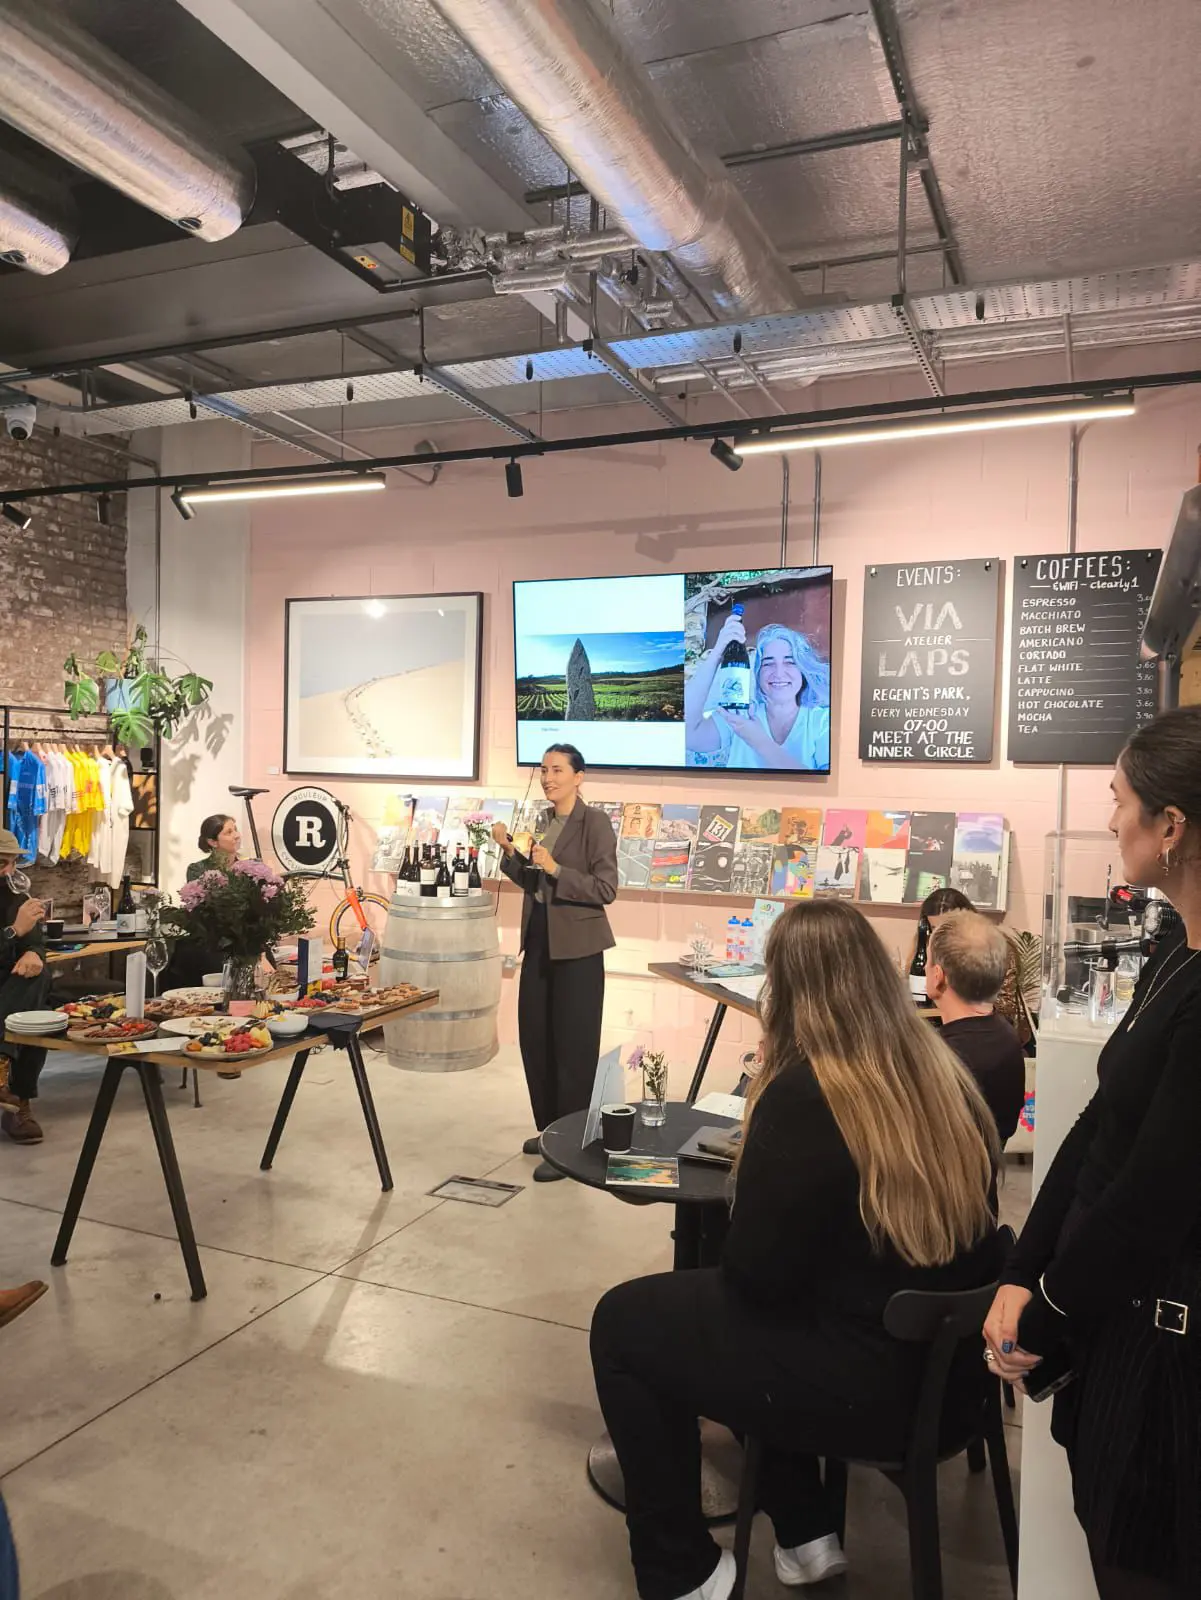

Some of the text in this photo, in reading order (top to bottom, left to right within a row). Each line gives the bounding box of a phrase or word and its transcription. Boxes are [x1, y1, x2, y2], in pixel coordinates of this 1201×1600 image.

[1036, 555, 1131, 580] COFFEES:
[896, 565, 961, 587] EVENTS:
[1022, 598, 1076, 608] ESPRESSO
[895, 601, 962, 632] VIA
[1021, 610, 1081, 621] MACCHIATO
[1019, 623, 1086, 635] BATCH BREW
[904, 634, 952, 646] ATELIER
[1018, 636, 1084, 649] AMERICANO
[1019, 650, 1066, 660] CORTADO
[878, 648, 970, 678] LAPS
[1018, 663, 1046, 673] FLAT
[1049, 662, 1084, 673] WHITE
[1017, 675, 1053, 685] LATTE
[872, 686, 971, 701] REGENT'S PARK,
[1017, 688, 1075, 697] CAPPUCINO
[1017, 700, 1041, 710] HOT
[1044, 700, 1104, 710] CHOCOLATE
[871, 707, 970, 718] EVERY WEDNESDAY
[1017, 713, 1053, 722] MOCHA
[1018, 724, 1039, 734] TEA
[872, 730, 974, 745] MEET AT THE
[868, 744, 975, 758] INNER CIRCLE
[293, 792, 327, 800] ROULEUR
[295, 816, 326, 848] R
[708, 820, 728, 840] 131
